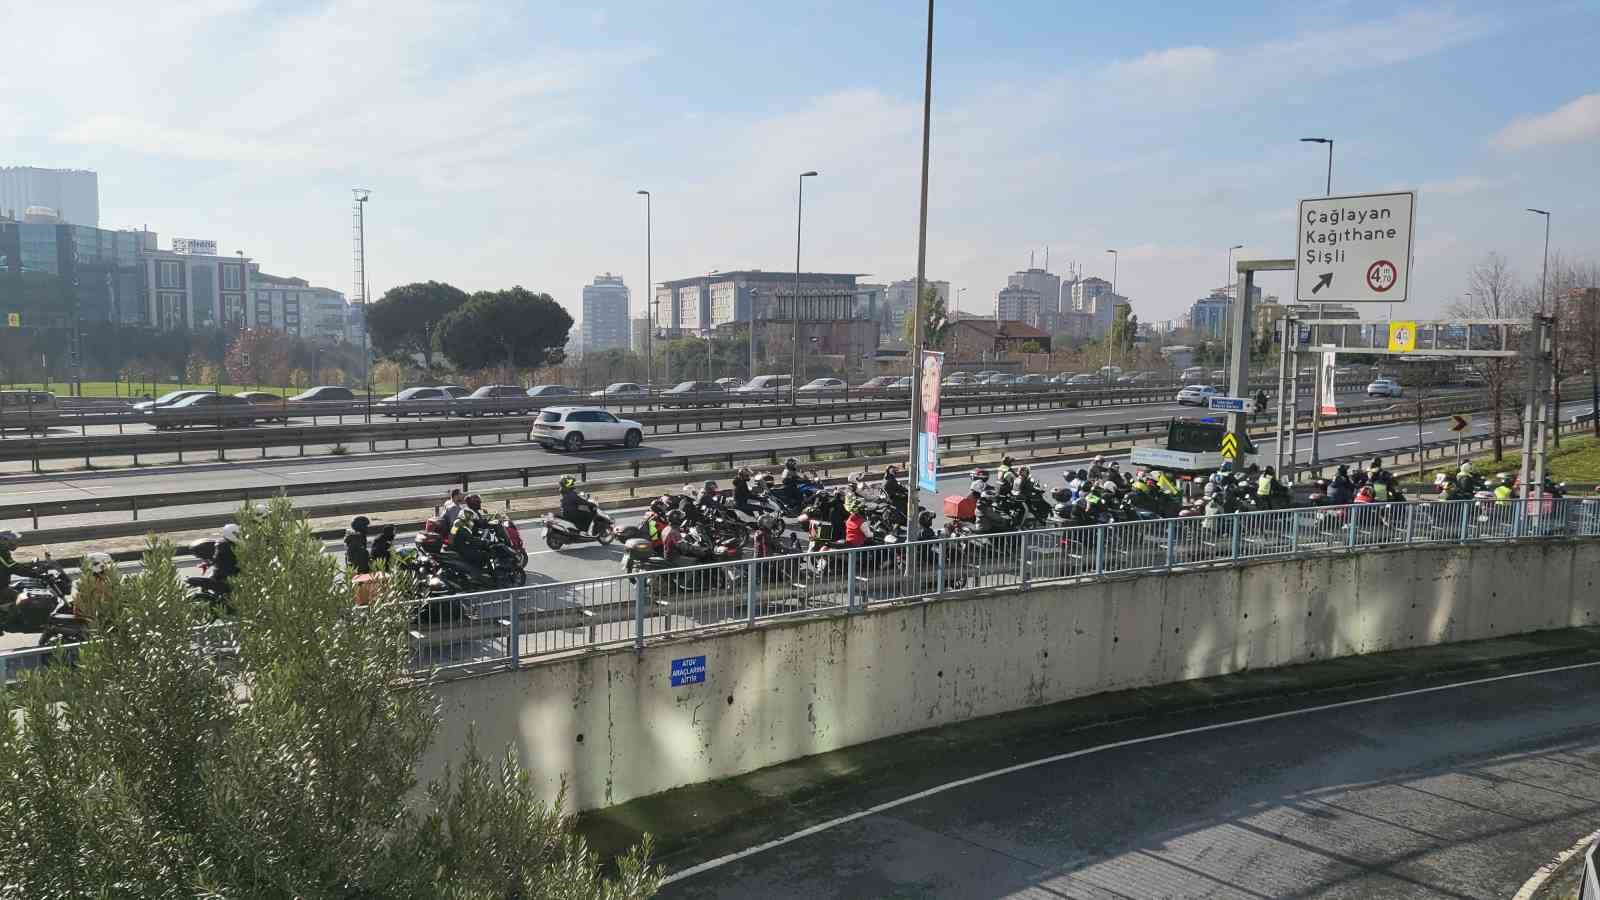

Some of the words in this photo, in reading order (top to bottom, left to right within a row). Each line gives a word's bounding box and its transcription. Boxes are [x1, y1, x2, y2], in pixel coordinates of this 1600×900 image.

[1306, 208, 1391, 226] Çağlayan
[1306, 227, 1397, 246] Kağıthane
[1306, 248, 1345, 265] Şişli
